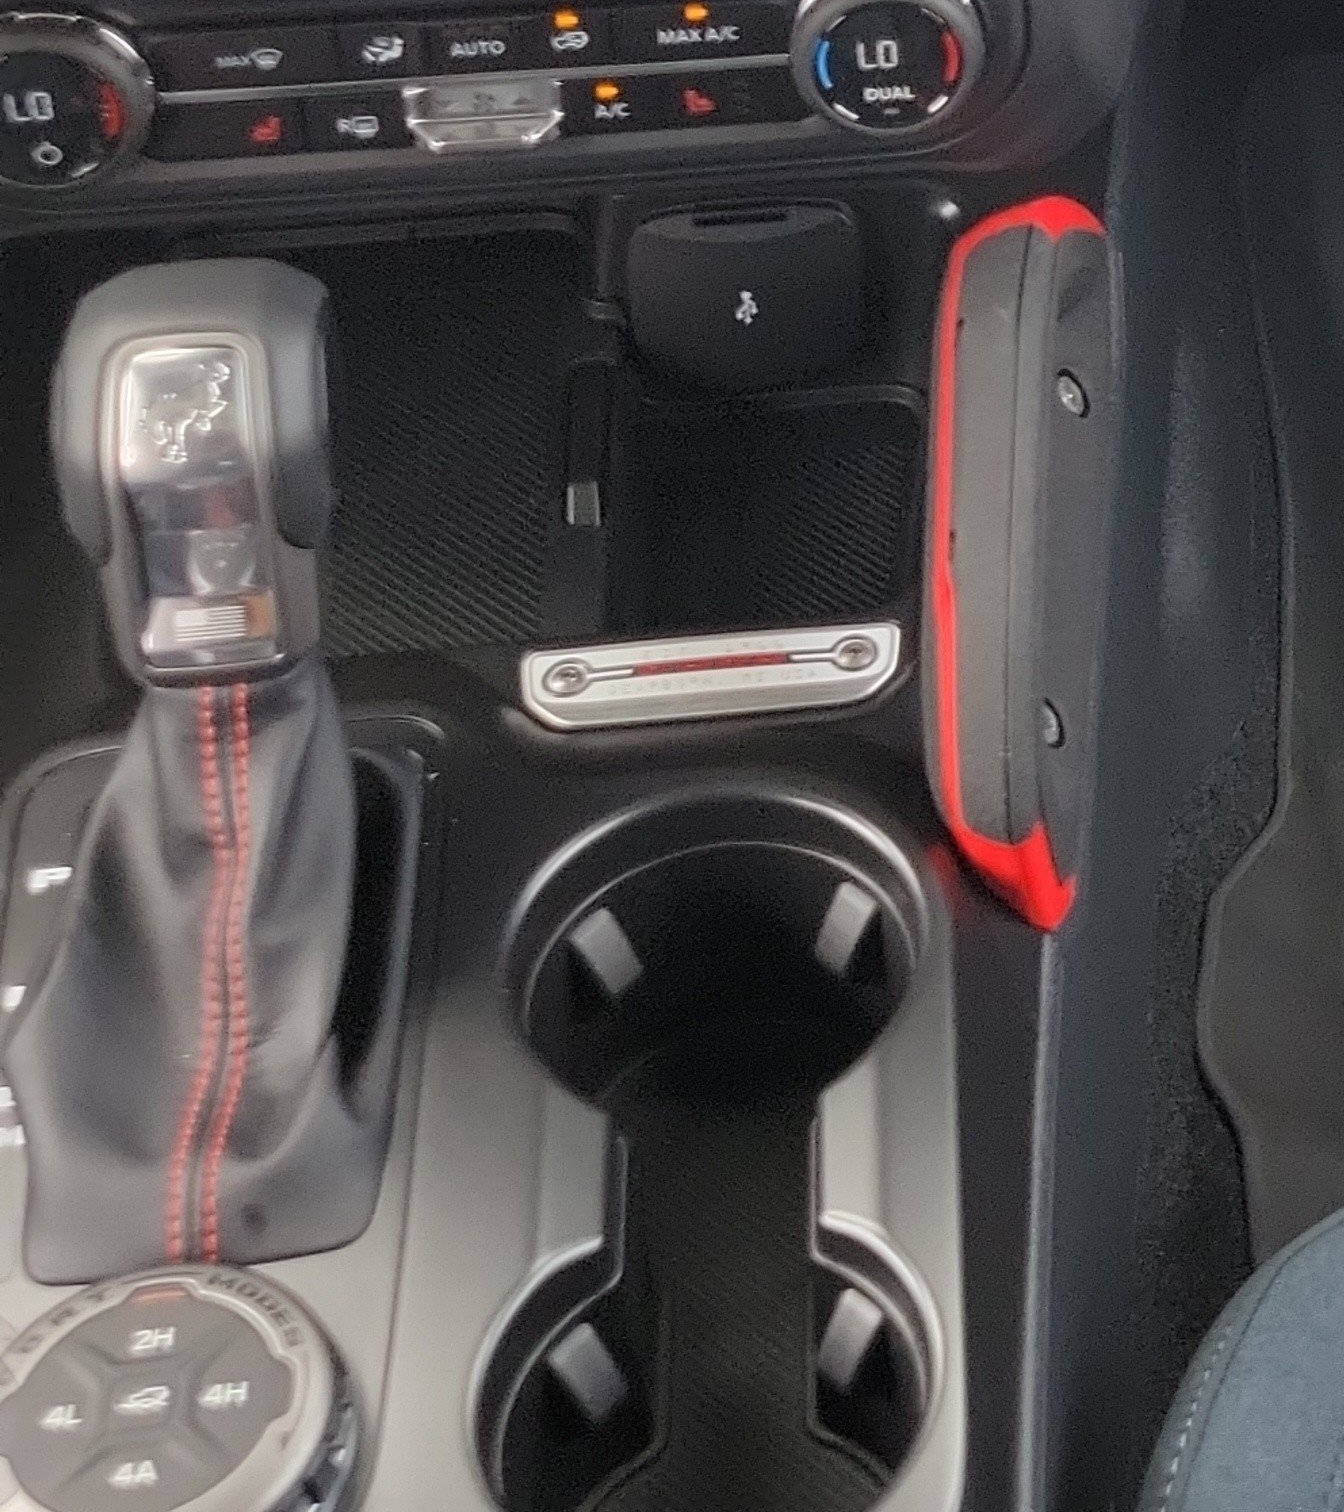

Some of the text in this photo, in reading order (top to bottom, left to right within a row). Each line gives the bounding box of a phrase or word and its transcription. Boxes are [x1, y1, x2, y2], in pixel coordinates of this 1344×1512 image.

[451, 39, 506, 58] AUTO
[657, 25, 740, 46] MAX A/C
[854, 39, 898, 71] LO
[862, 84, 916, 102] DUAL
[3, 91, 54, 124] LO
[594, 101, 631, 120] A/C
[128, 1326, 176, 1355] 2H
[198, 1380, 250, 1409] 4H
[40, 1403, 84, 1431] 4L
[108, 1459, 158, 1488] 4A
